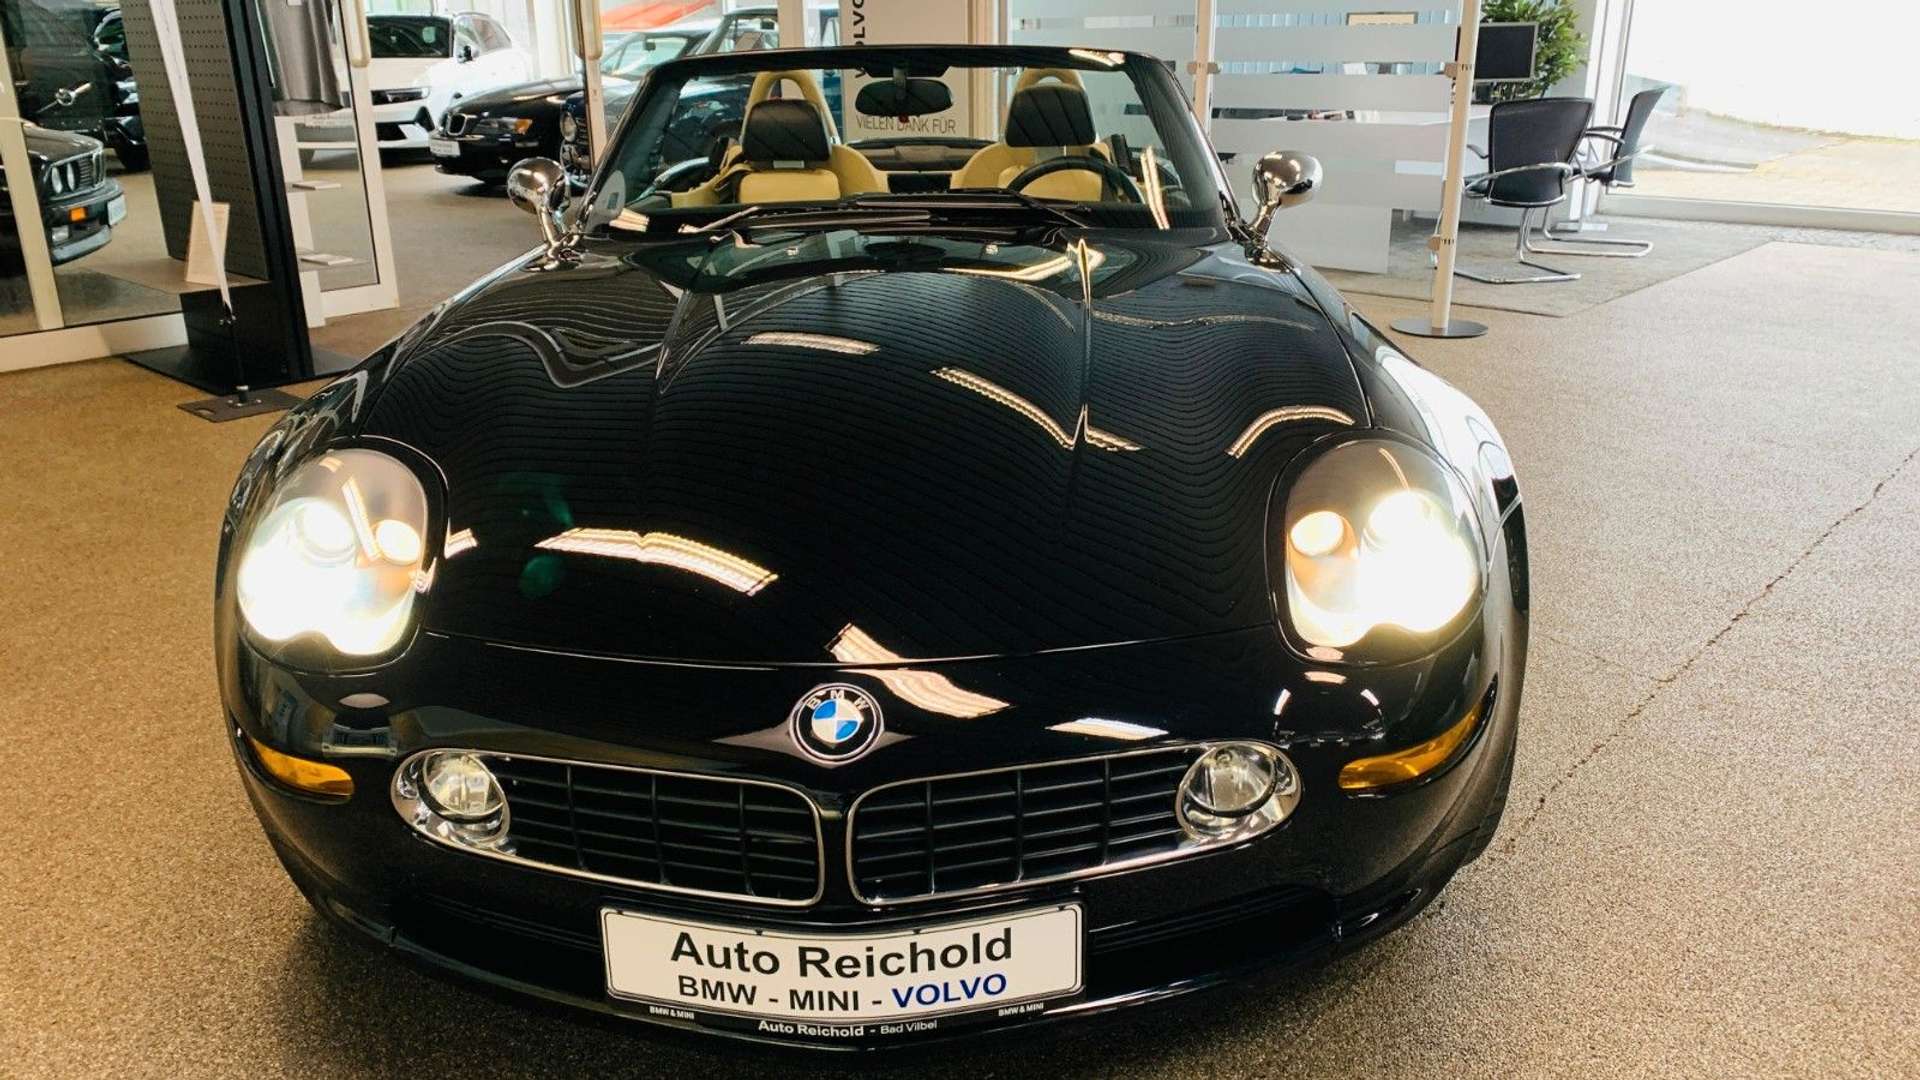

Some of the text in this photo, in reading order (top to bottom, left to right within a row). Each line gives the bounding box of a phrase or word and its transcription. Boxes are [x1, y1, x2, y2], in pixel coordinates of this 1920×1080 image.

[856, 115, 957, 134] VIELEN DANK FÜR
[806, 690, 869, 710] BMW
[670, 927, 1012, 978] Auto Reichold
[678, 975, 757, 1005] BMW
[789, 989, 859, 1011] MINI
[892, 973, 1007, 1008] VOLVO
[649, 1005, 670, 1016] BMW
[676, 1010, 695, 1019] MINI
[998, 1007, 1018, 1016] BMW
[1026, 1002, 1044, 1012] MINI
[758, 1020, 794, 1034] Auto
[798, 1024, 864, 1037] Reichold
[880, 1023, 904, 1035] Bad
[906, 1020, 938, 1033] Vilbel
